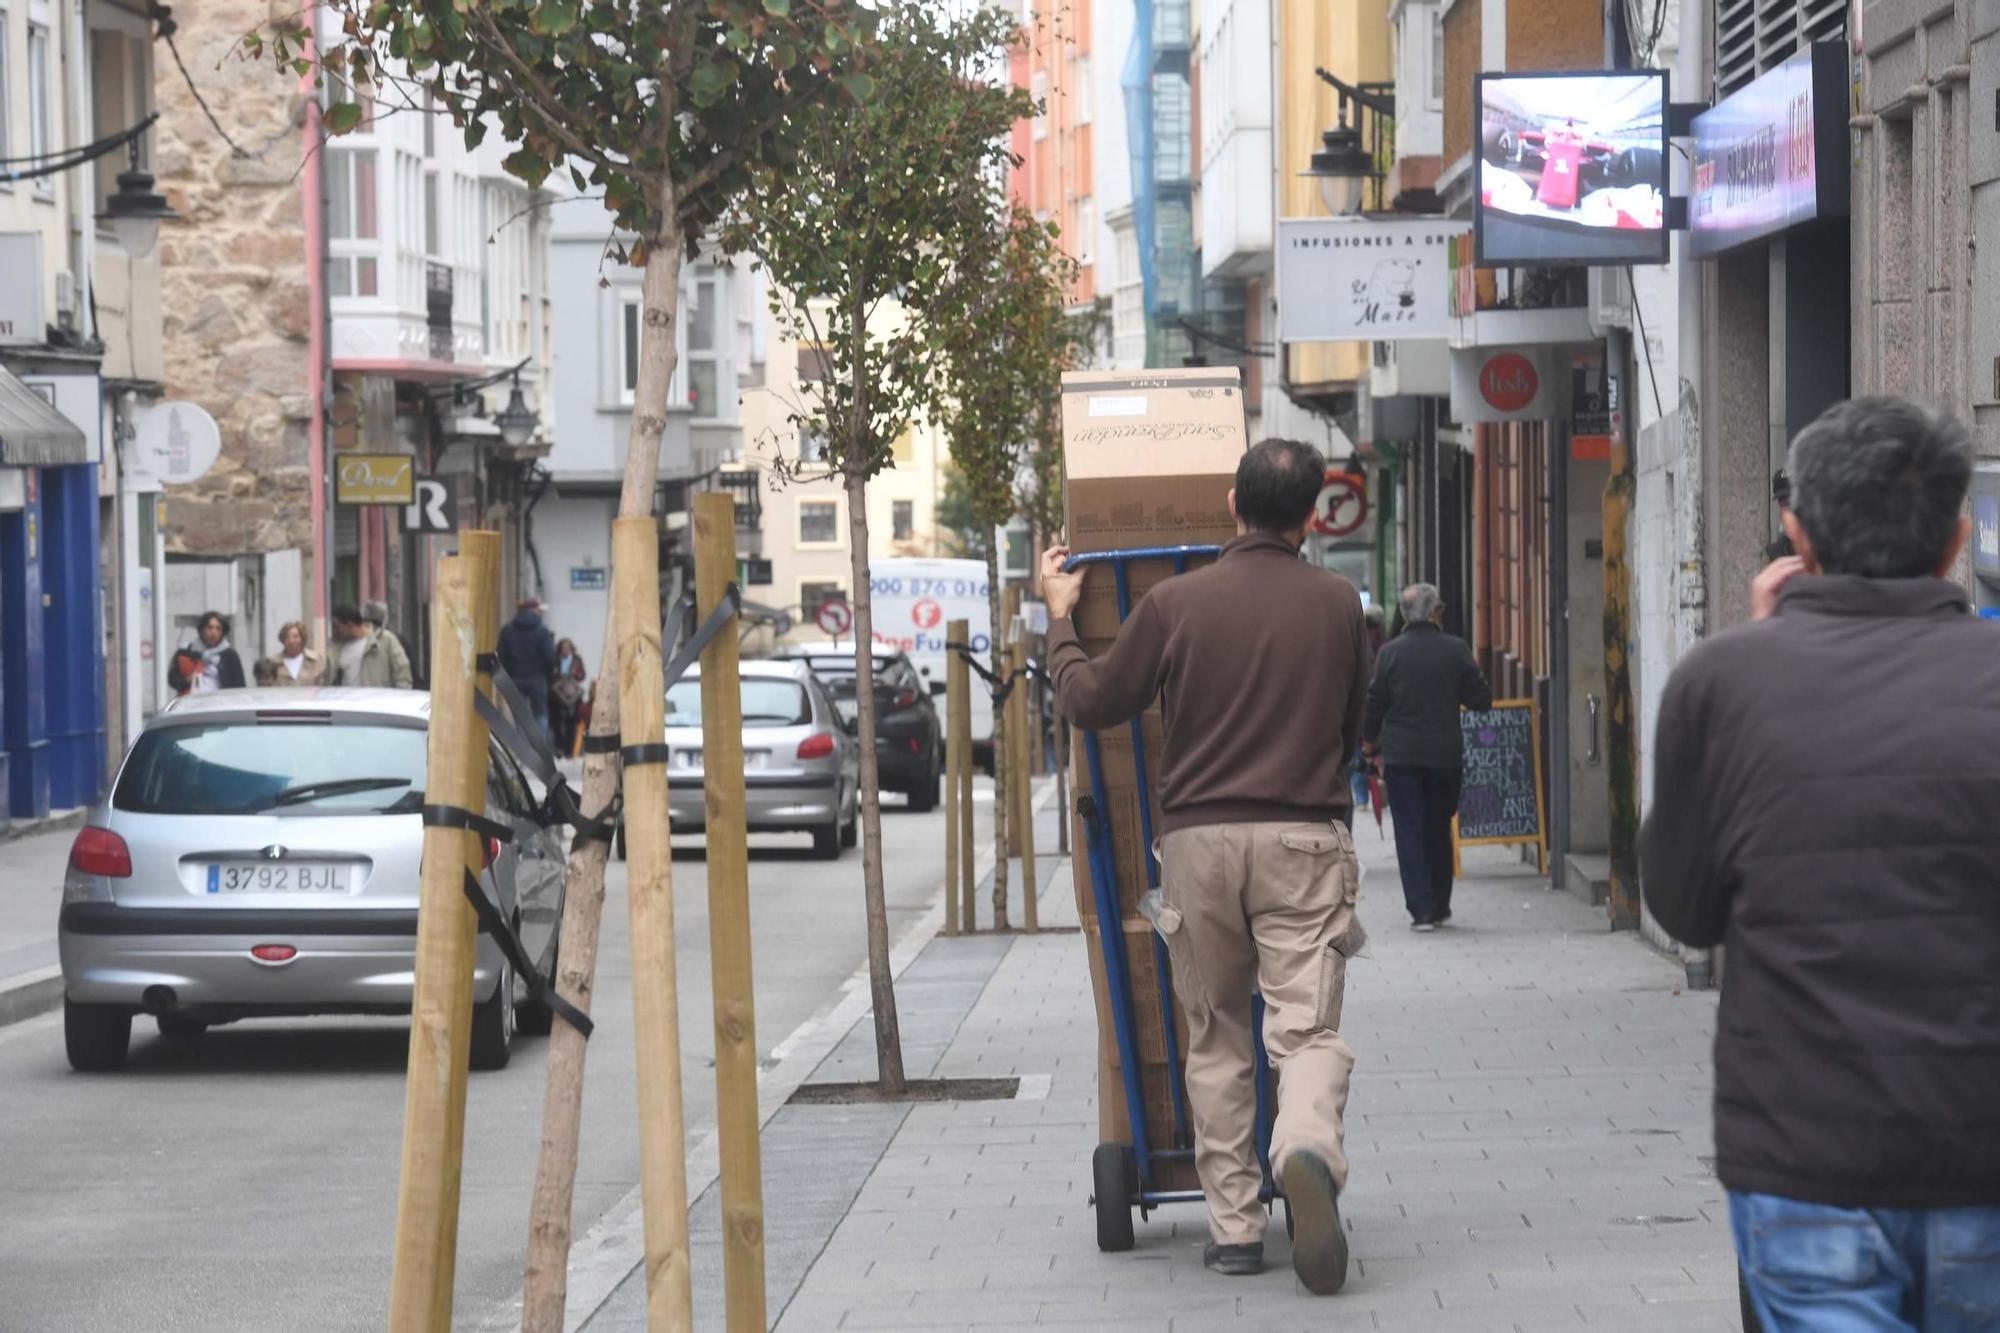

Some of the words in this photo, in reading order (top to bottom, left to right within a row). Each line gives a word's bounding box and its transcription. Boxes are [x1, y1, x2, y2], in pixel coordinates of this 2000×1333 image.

[1293, 235, 1393, 248] INFUSIONES
[1405, 235, 1413, 246] A
[1425, 234, 1446, 245] GR
[1354, 302, 1416, 326] Mate
[406, 480, 449, 529] R
[870, 578, 902, 595] 900
[910, 578, 946, 596] 876
[954, 581, 989, 597] 016
[225, 866, 289, 890] 3792
[298, 866, 346, 890] BJL
